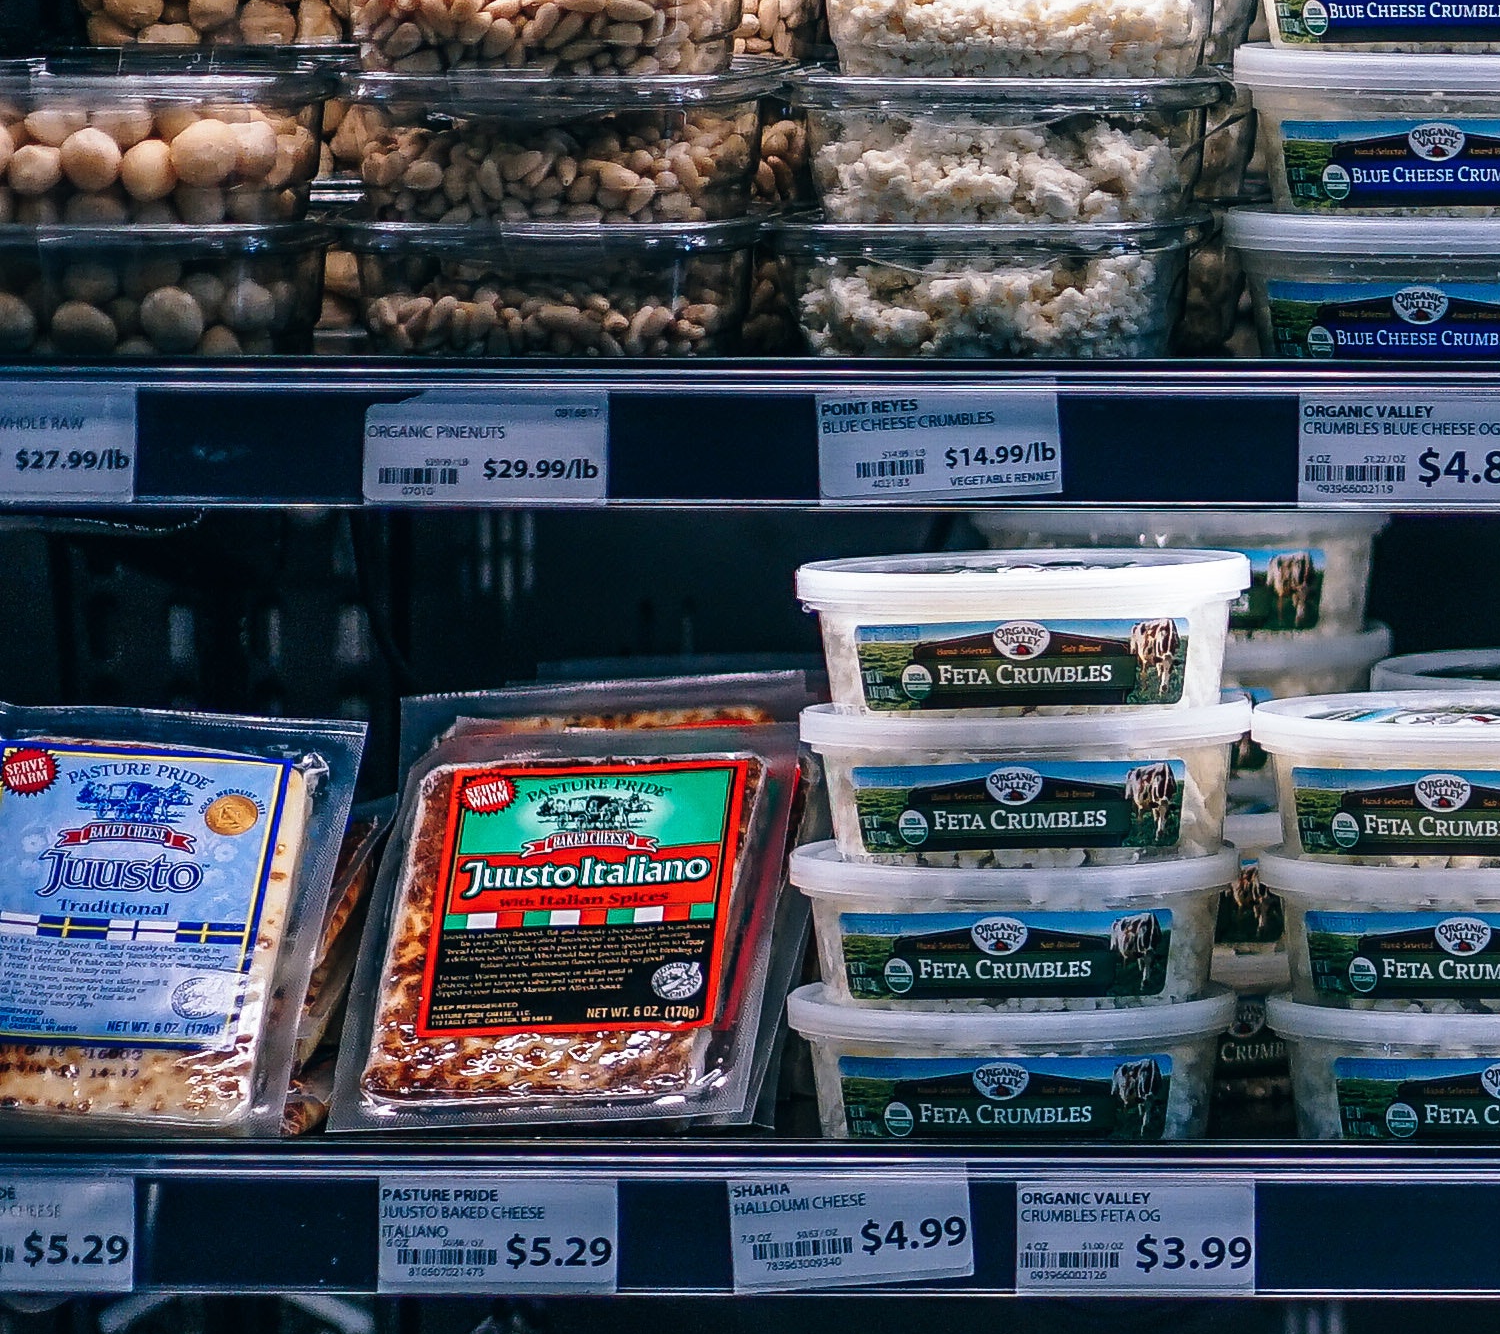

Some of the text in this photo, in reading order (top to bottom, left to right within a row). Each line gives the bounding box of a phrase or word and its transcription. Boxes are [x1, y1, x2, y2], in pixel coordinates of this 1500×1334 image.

[1328, 3, 1365, 20] BLUE
[1366, 1, 1427, 18] CHEESE
[365, 424, 506, 440] ORGANIC PINENUTS
[482, 457, 599, 481] $29.99/lb
[937, 664, 1113, 685] FETA CRUMBLES
[37, 850, 204, 898] Juusto
[56, 898, 170, 917] Traditional
[381, 1188, 499, 1202] PASTURE PRIDE
[505, 1232, 613, 1270] $5.29
[1135, 1233, 1252, 1274] $3.99
